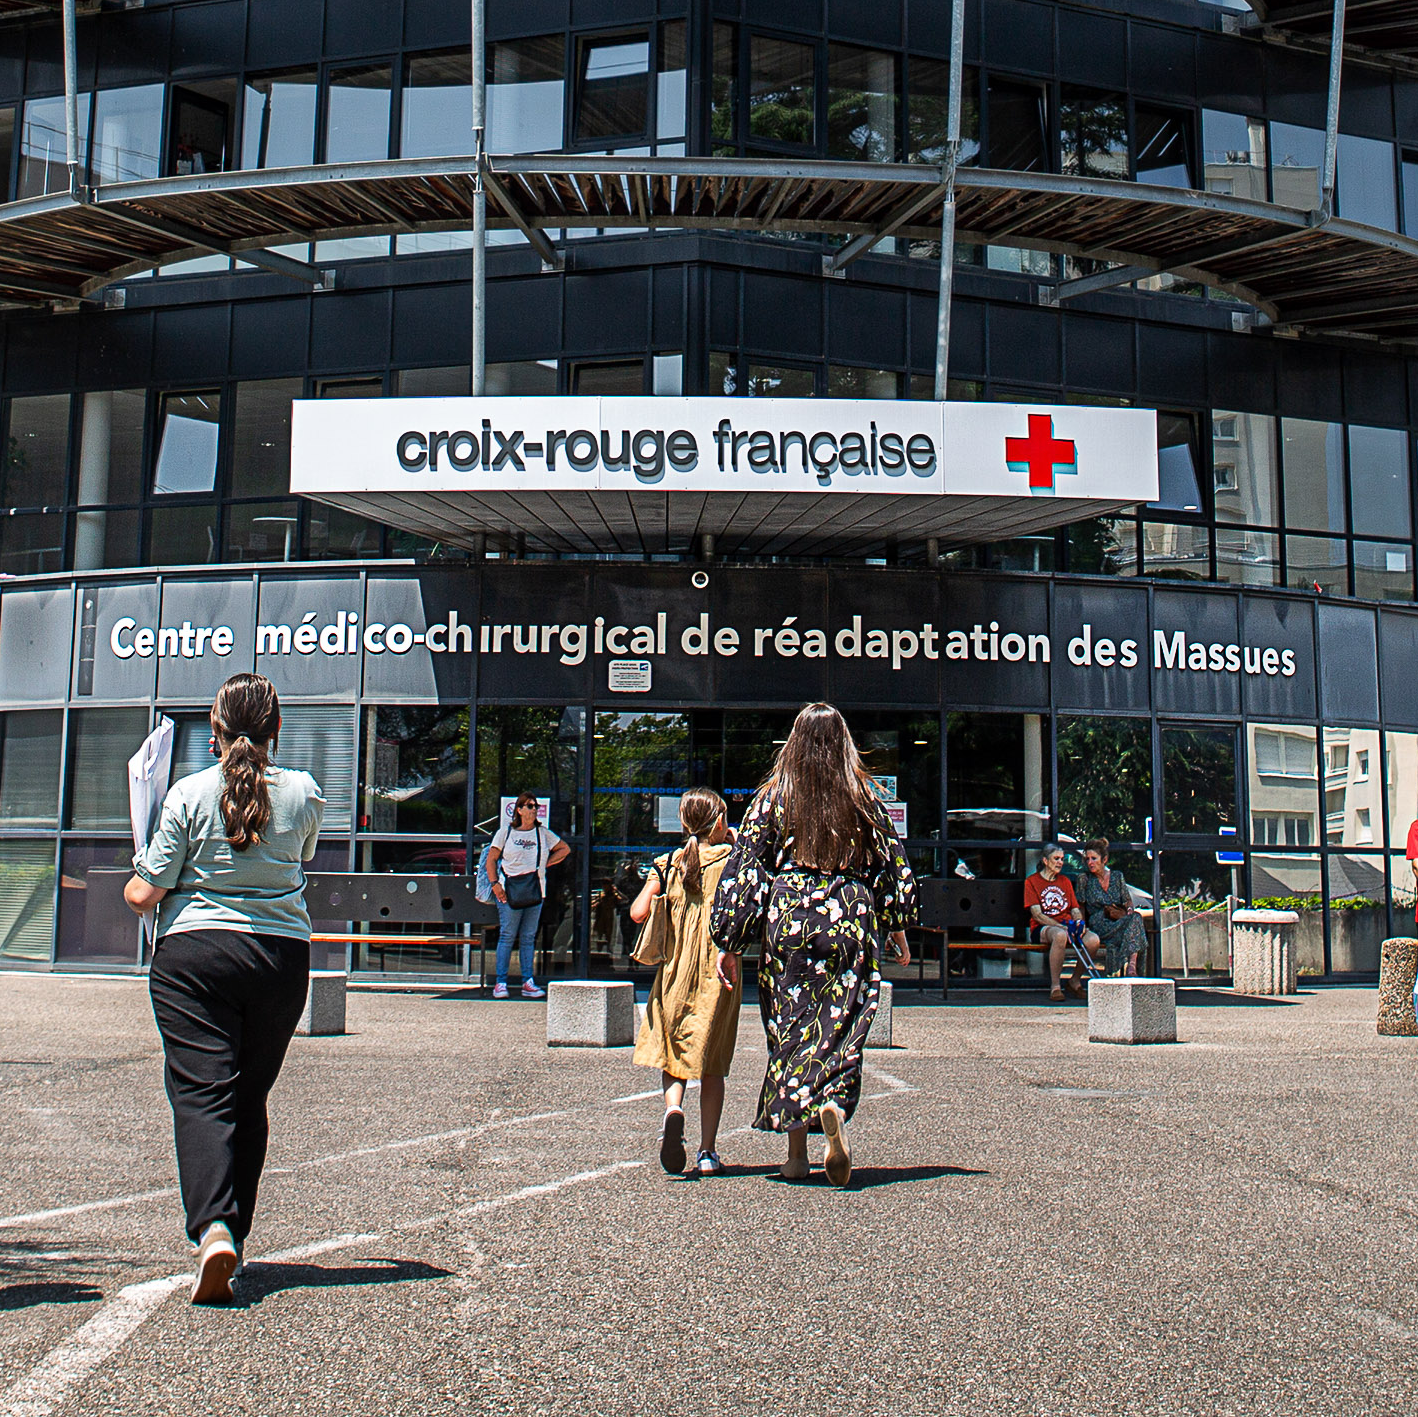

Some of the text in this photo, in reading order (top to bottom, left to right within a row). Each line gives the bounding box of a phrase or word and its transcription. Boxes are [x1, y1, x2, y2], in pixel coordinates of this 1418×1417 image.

[396, 418, 936, 481] croix-rouge française
[110, 616, 234, 659] Centre
[681, 612, 740, 655] de
[753, 615, 1051, 669] réadaptation
[1067, 623, 1138, 667] des
[1153, 629, 1297, 676] Massues
